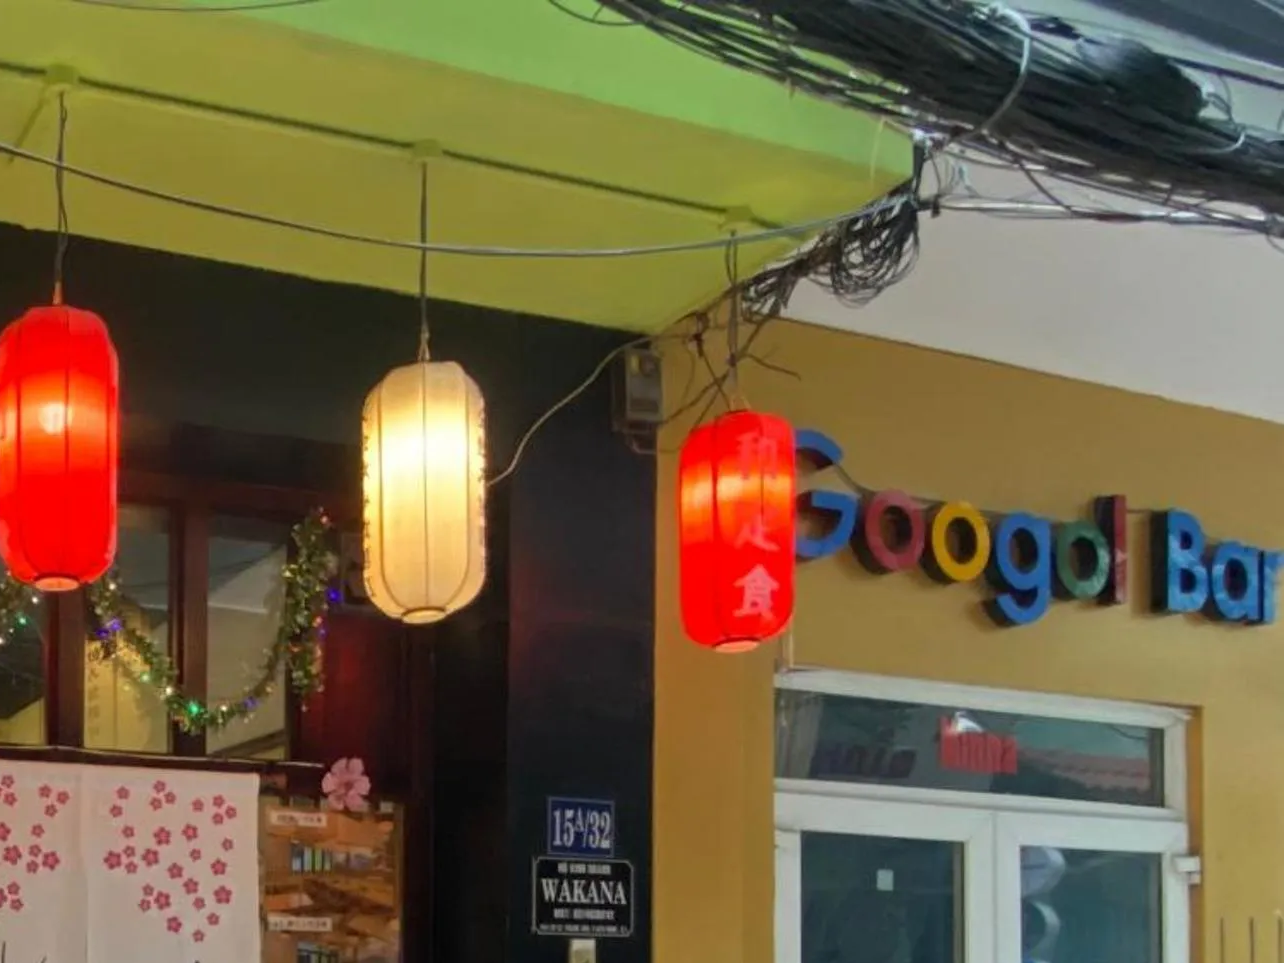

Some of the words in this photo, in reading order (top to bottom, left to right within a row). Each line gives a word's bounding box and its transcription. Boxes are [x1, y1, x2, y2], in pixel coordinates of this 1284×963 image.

[1162, 507, 1284, 625] Bar
[552, 807, 612, 850] 15A/32
[541, 878, 628, 905] WAKANA
